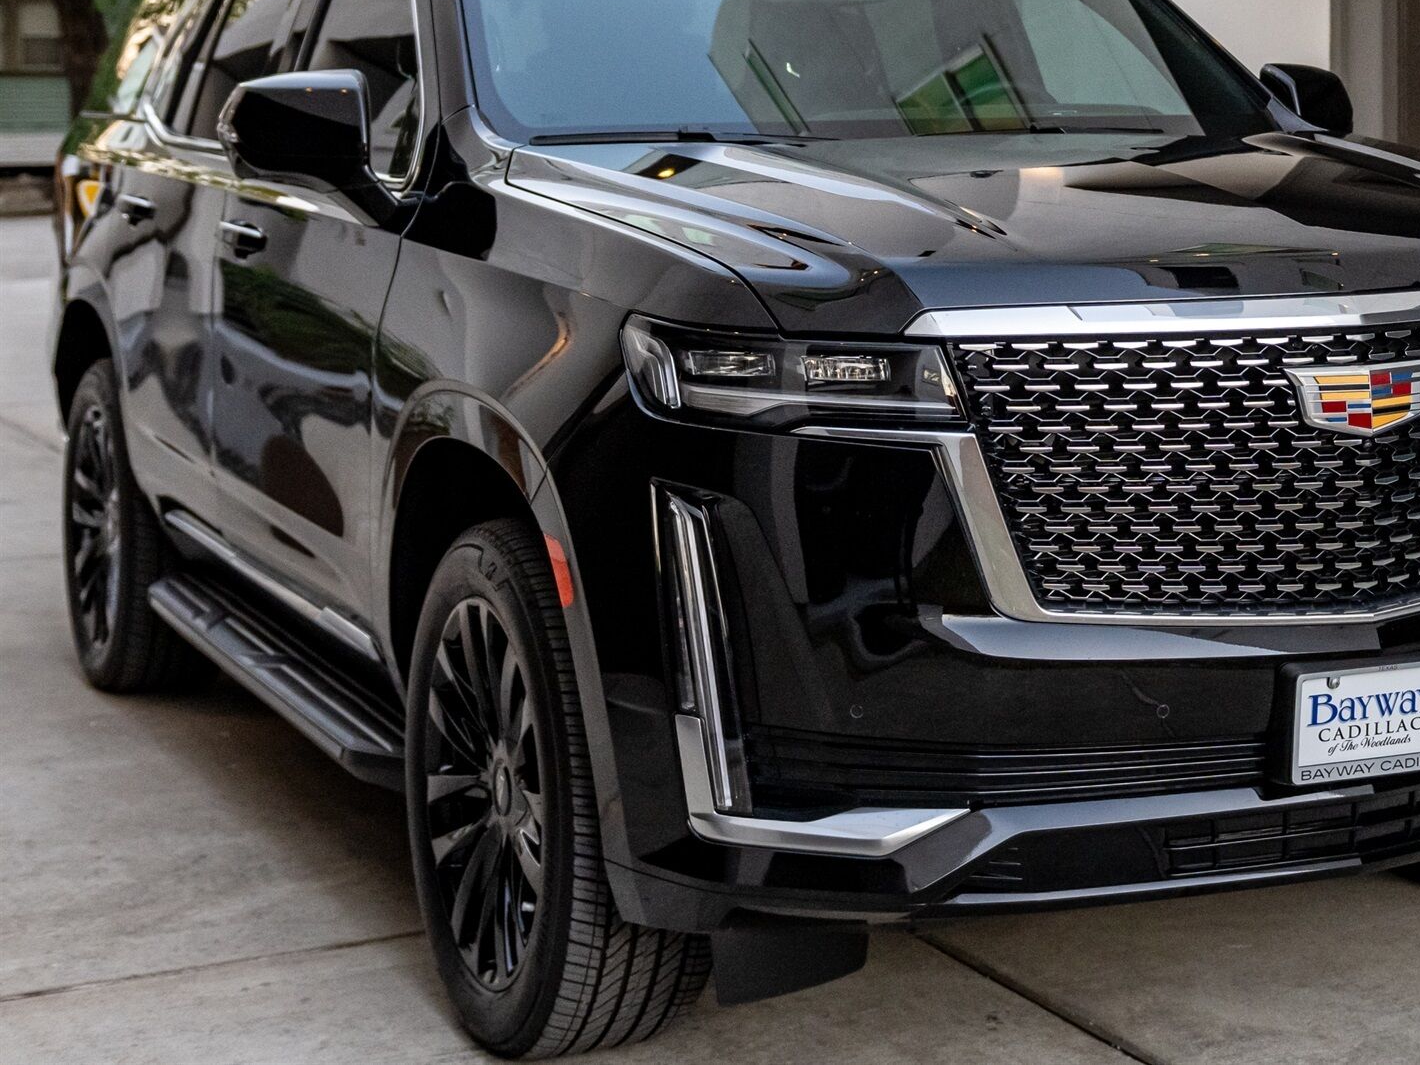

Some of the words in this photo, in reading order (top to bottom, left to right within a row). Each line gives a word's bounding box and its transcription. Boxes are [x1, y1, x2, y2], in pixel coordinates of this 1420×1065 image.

[1327, 743, 1338, 756] of
[1339, 739, 1358, 752] The
[1360, 734, 1411, 748] Woodlands
[1301, 762, 1376, 781] BAYWAY
